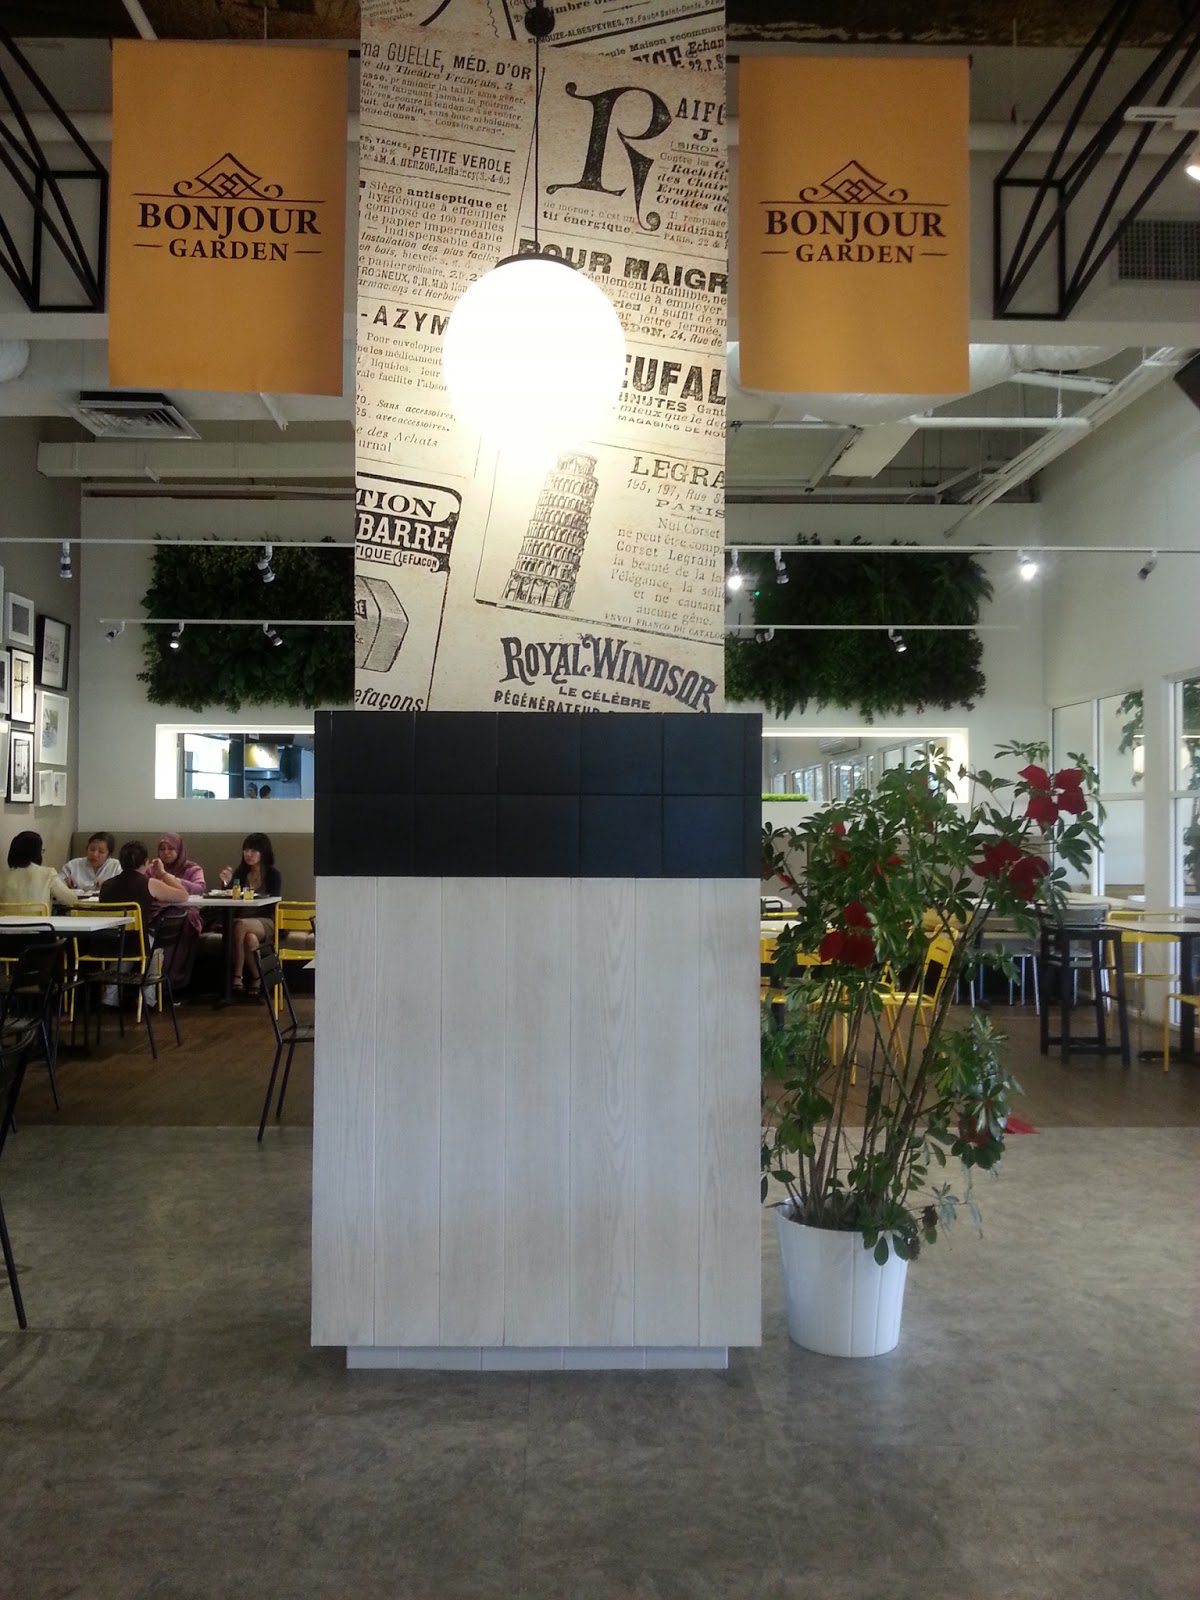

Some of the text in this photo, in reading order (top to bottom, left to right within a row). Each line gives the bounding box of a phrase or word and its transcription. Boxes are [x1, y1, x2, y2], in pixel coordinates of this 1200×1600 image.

[629, 39, 666, 51] Maison
[376, 61, 390, 71] du
[388, 43, 445, 73] GUELLE,
[453, 54, 490, 73] MÉD.
[496, 62, 532, 80] D'OR
[693, 128, 718, 143] J.
[413, 145, 457, 164] PETITE
[463, 154, 511, 174] VEROLE
[407, 188, 492, 210] antiseptique
[137, 202, 321, 239] BONJOUR
[364, 211, 378, 222] de
[382, 213, 421, 229] papier
[423, 210, 437, 220] de
[765, 210, 946, 244] BONJOUR
[361, 232, 417, 249] Installation
[472, 241, 501, 252] dans
[169, 238, 289, 261] GARDEN
[795, 243, 915, 264] GARDEN
[367, 332, 390, 344] Pour
[379, 373, 413, 385] facilite
[356, 513, 450, 554] BARRE
[618, 529, 632, 538] ne
[684, 523, 720, 539] Corset
[616, 540, 716, 568] Corset Legrain
[678, 599, 720, 613] causant
[499, 636, 718, 713] ROYAL WINDSOR
[558, 686, 577, 698] LE
